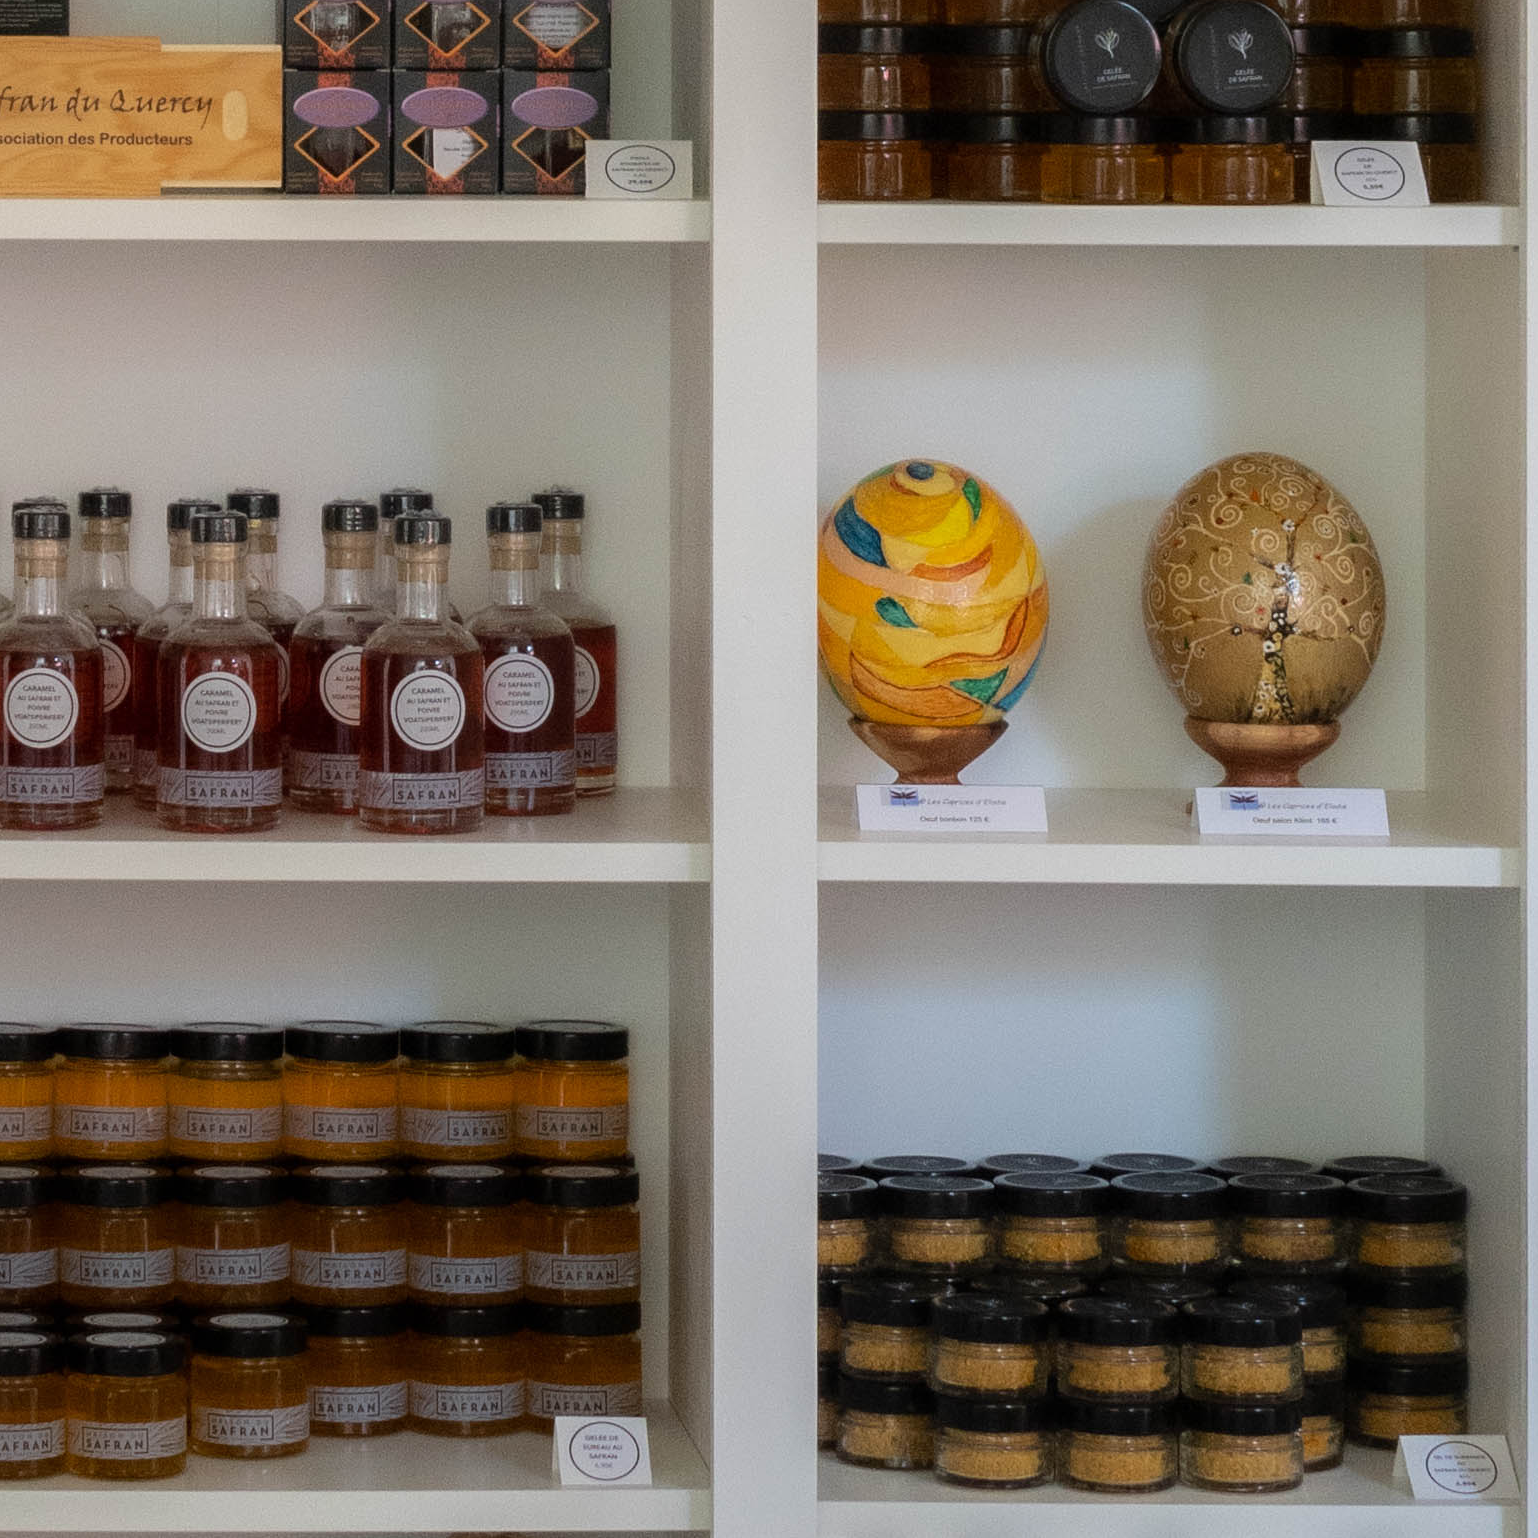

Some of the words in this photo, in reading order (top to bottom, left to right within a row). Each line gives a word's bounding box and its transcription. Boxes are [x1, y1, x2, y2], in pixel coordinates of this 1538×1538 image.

[65, 87, 101, 123] du
[109, 88, 214, 131] Quercy
[68, 132, 95, 146] des
[99, 132, 194, 146] Producteurs
[22, 685, 56, 693] CARAMEL
[412, 686, 446, 695] CARAMEL
[417, 697, 442, 705] SAFRAN
[417, 706, 441, 714] POIVRE
[11, 783, 71, 795] SAFRAN
[189, 787, 250, 799] SAFRAN
[397, 789, 458, 800] SAFRAN
[83, 1267, 142, 1279] SAFRAN
[199, 1264, 259, 1275] SAFRAN
[86, 1439, 144, 1450] SAFRAN
